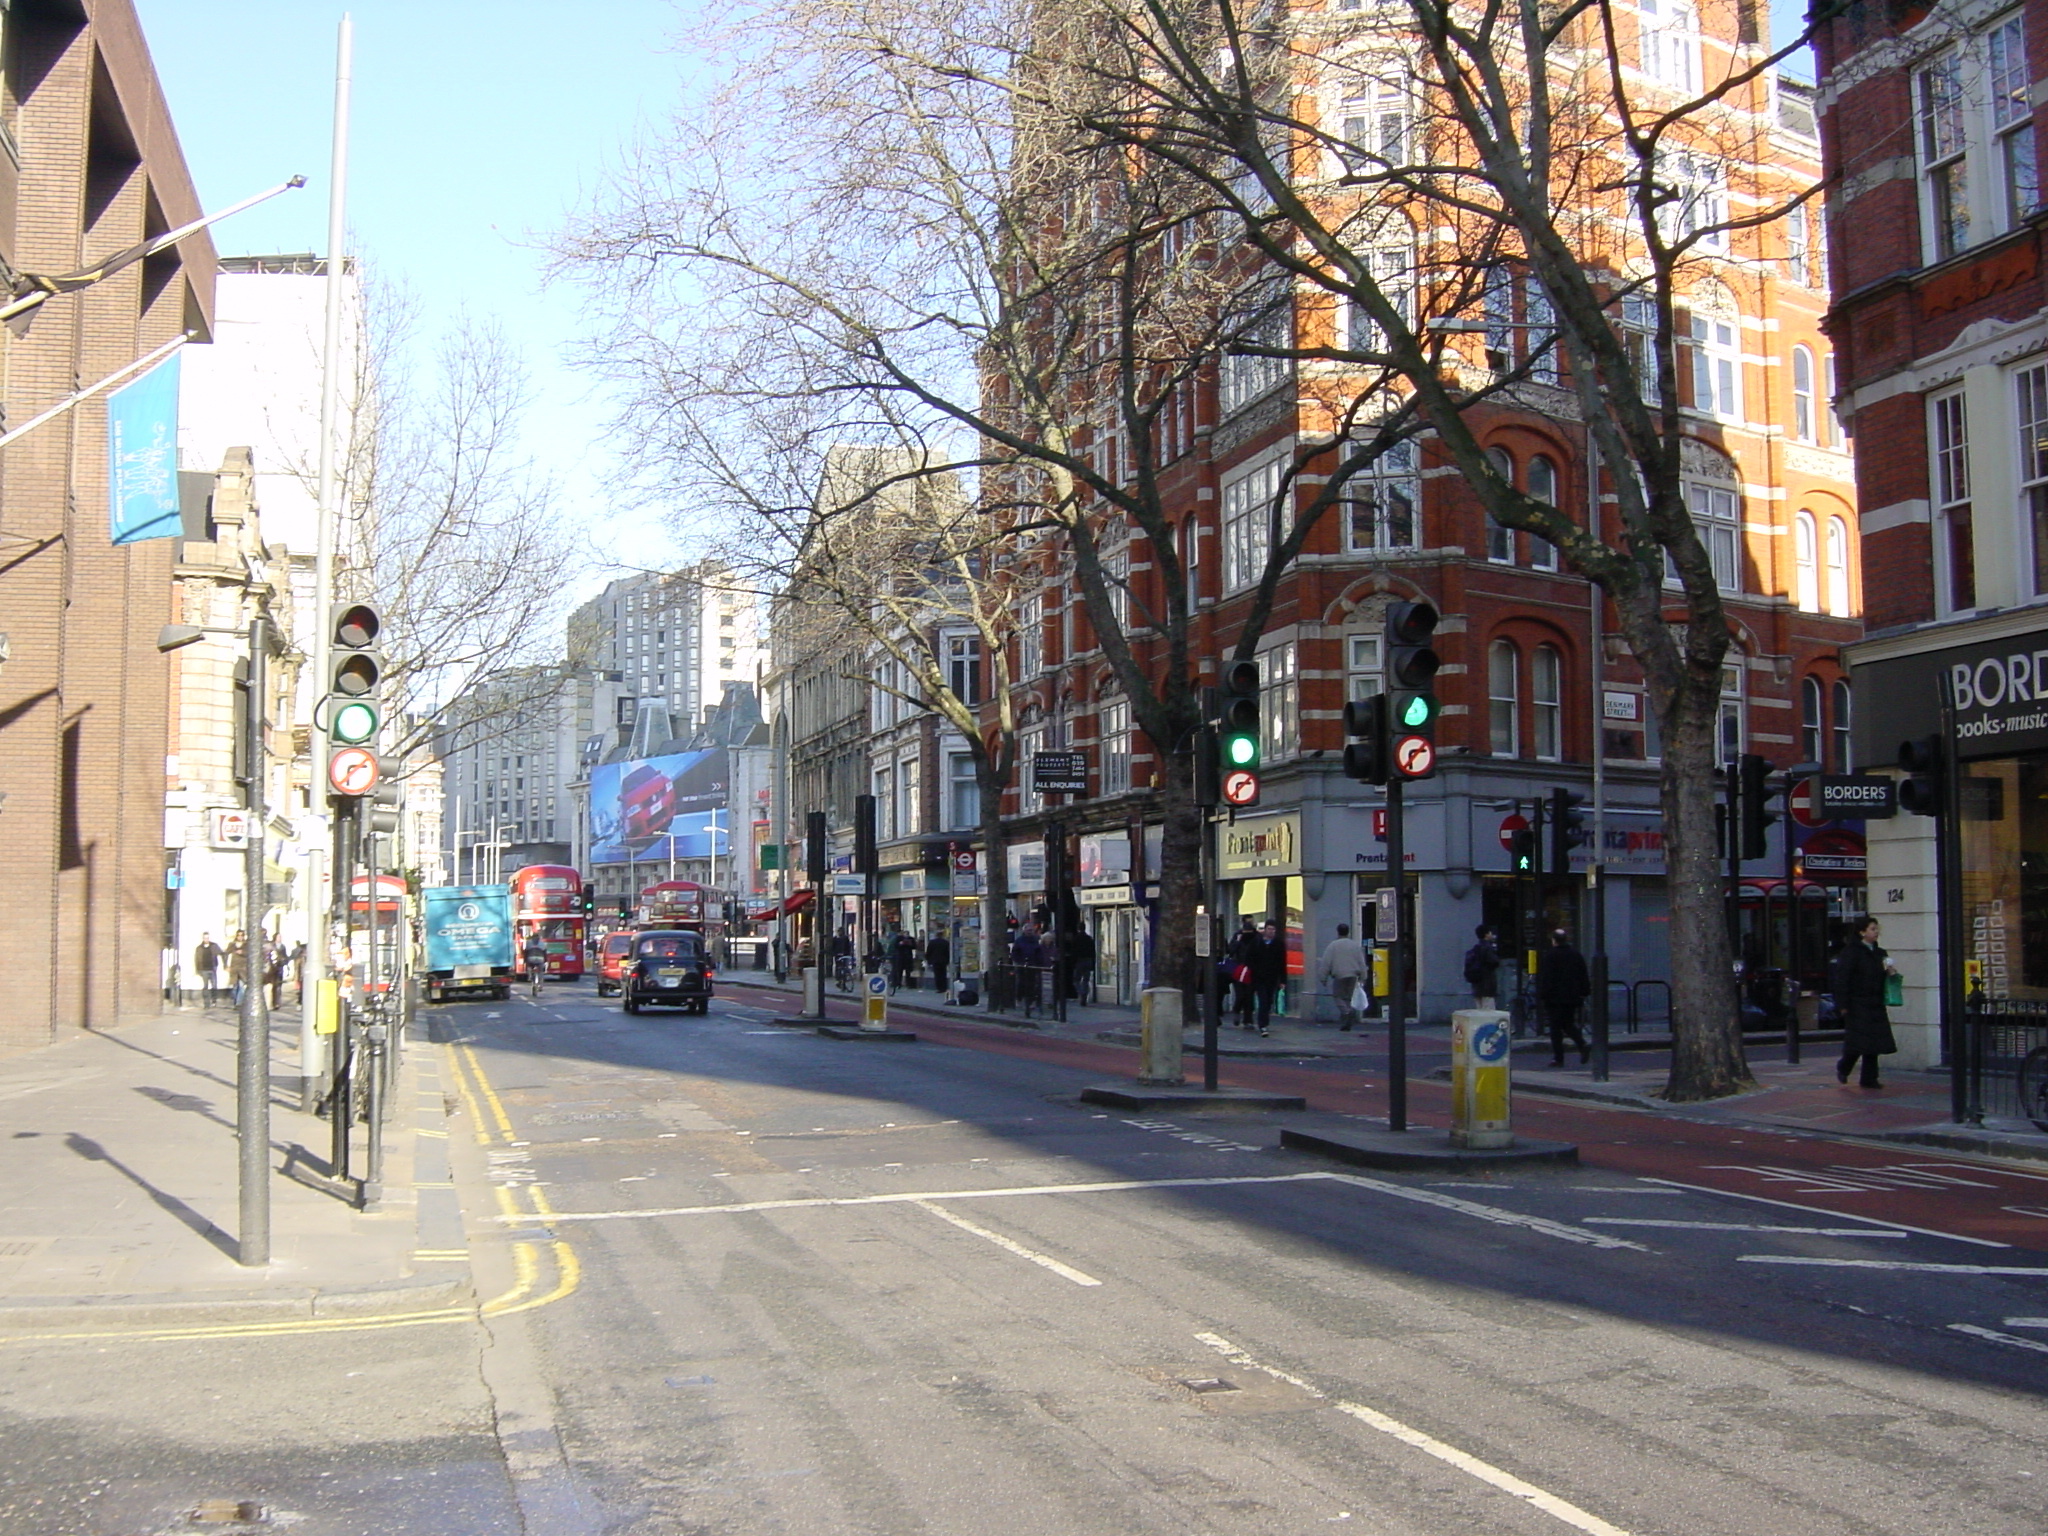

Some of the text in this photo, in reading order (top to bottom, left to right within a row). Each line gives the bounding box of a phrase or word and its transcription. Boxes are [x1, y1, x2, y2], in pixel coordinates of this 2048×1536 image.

[1035, 781, 1085, 789] ALL ENQUIRIES
[1823, 785, 1886, 800] BORDERS
[1887, 888, 1904, 903] 124
[437, 926, 501, 936] OMEGA
